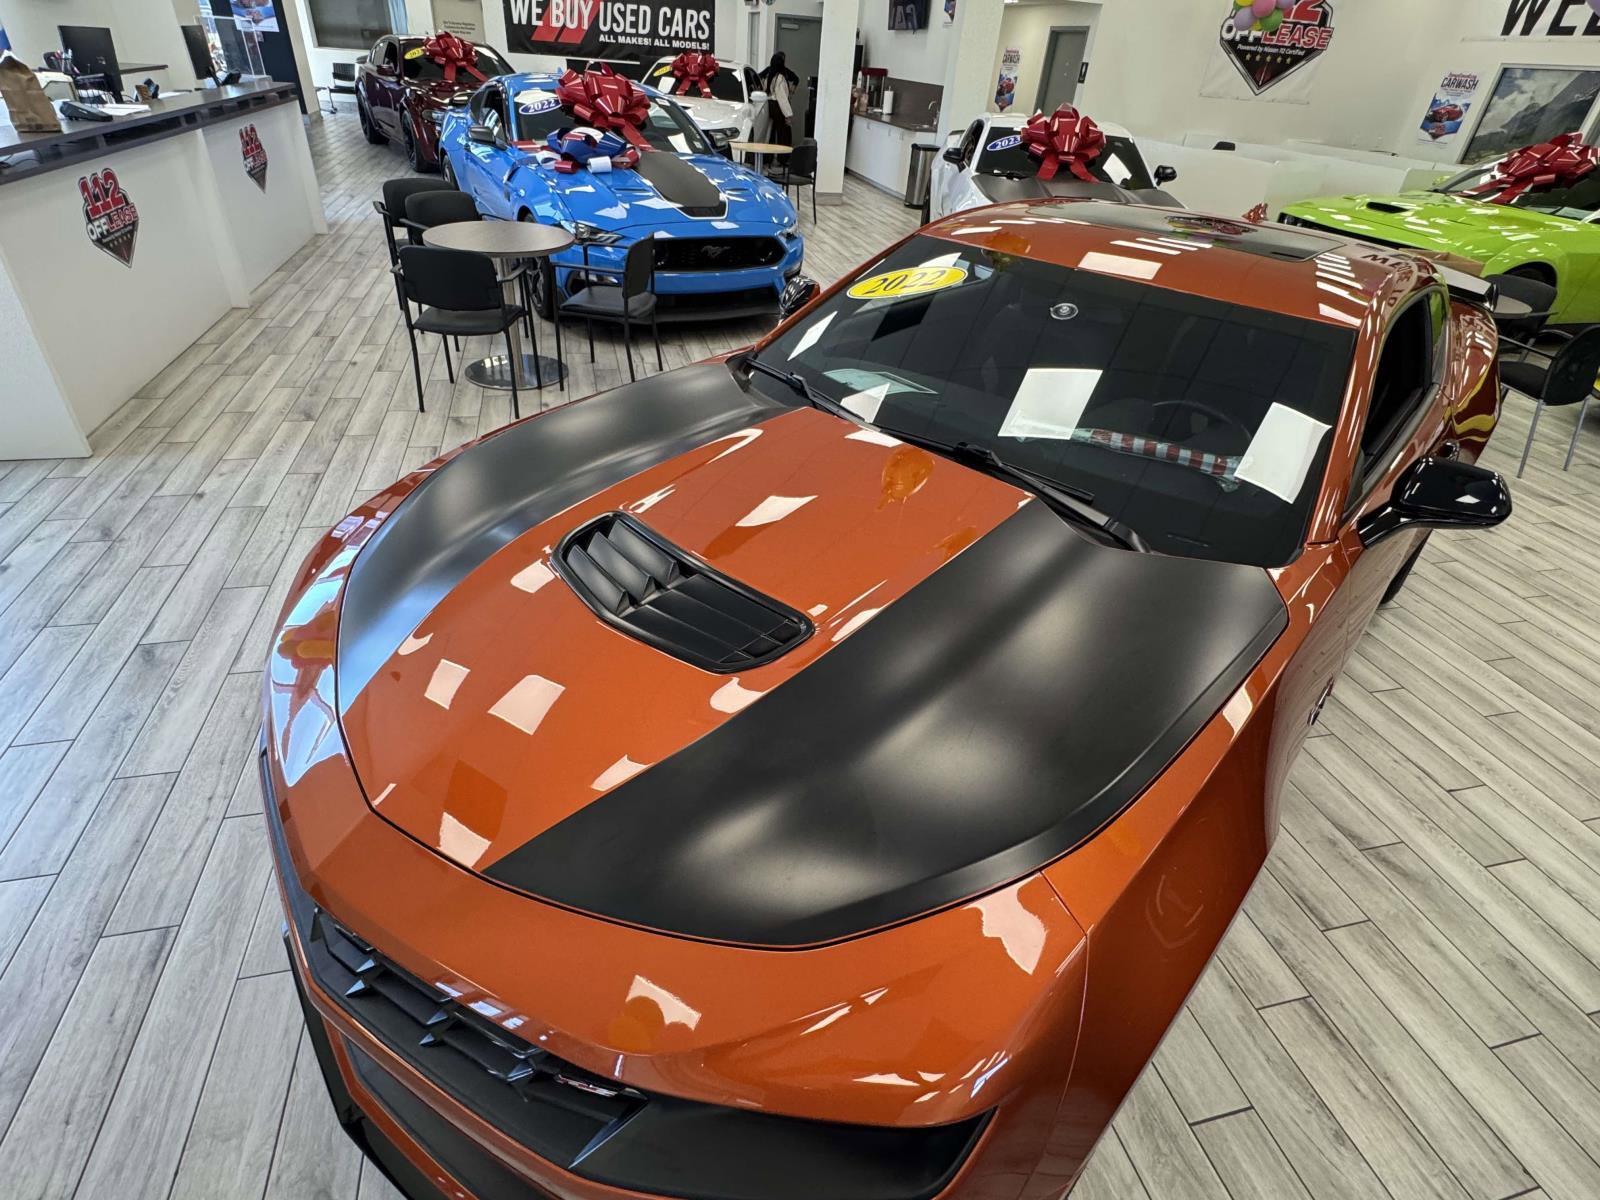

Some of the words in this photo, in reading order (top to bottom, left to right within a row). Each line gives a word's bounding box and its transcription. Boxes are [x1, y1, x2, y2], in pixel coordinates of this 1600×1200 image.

[510, 0, 543, 27] WE
[549, 0, 593, 31] BUY
[599, 2, 650, 35] USED
[658, 6, 710, 40] CARS
[599, 33, 617, 43] ALL
[618, 35, 652, 46] MAKES!
[654, 37, 670, 47] ALL
[672, 40, 710, 51] MODELS!
[1441, 77, 1479, 90] CARWASH
[528, 98, 556, 112] 2022
[239, 123, 262, 157] 112
[78, 167, 125, 219] 112
[862, 269, 947, 295] 2022
